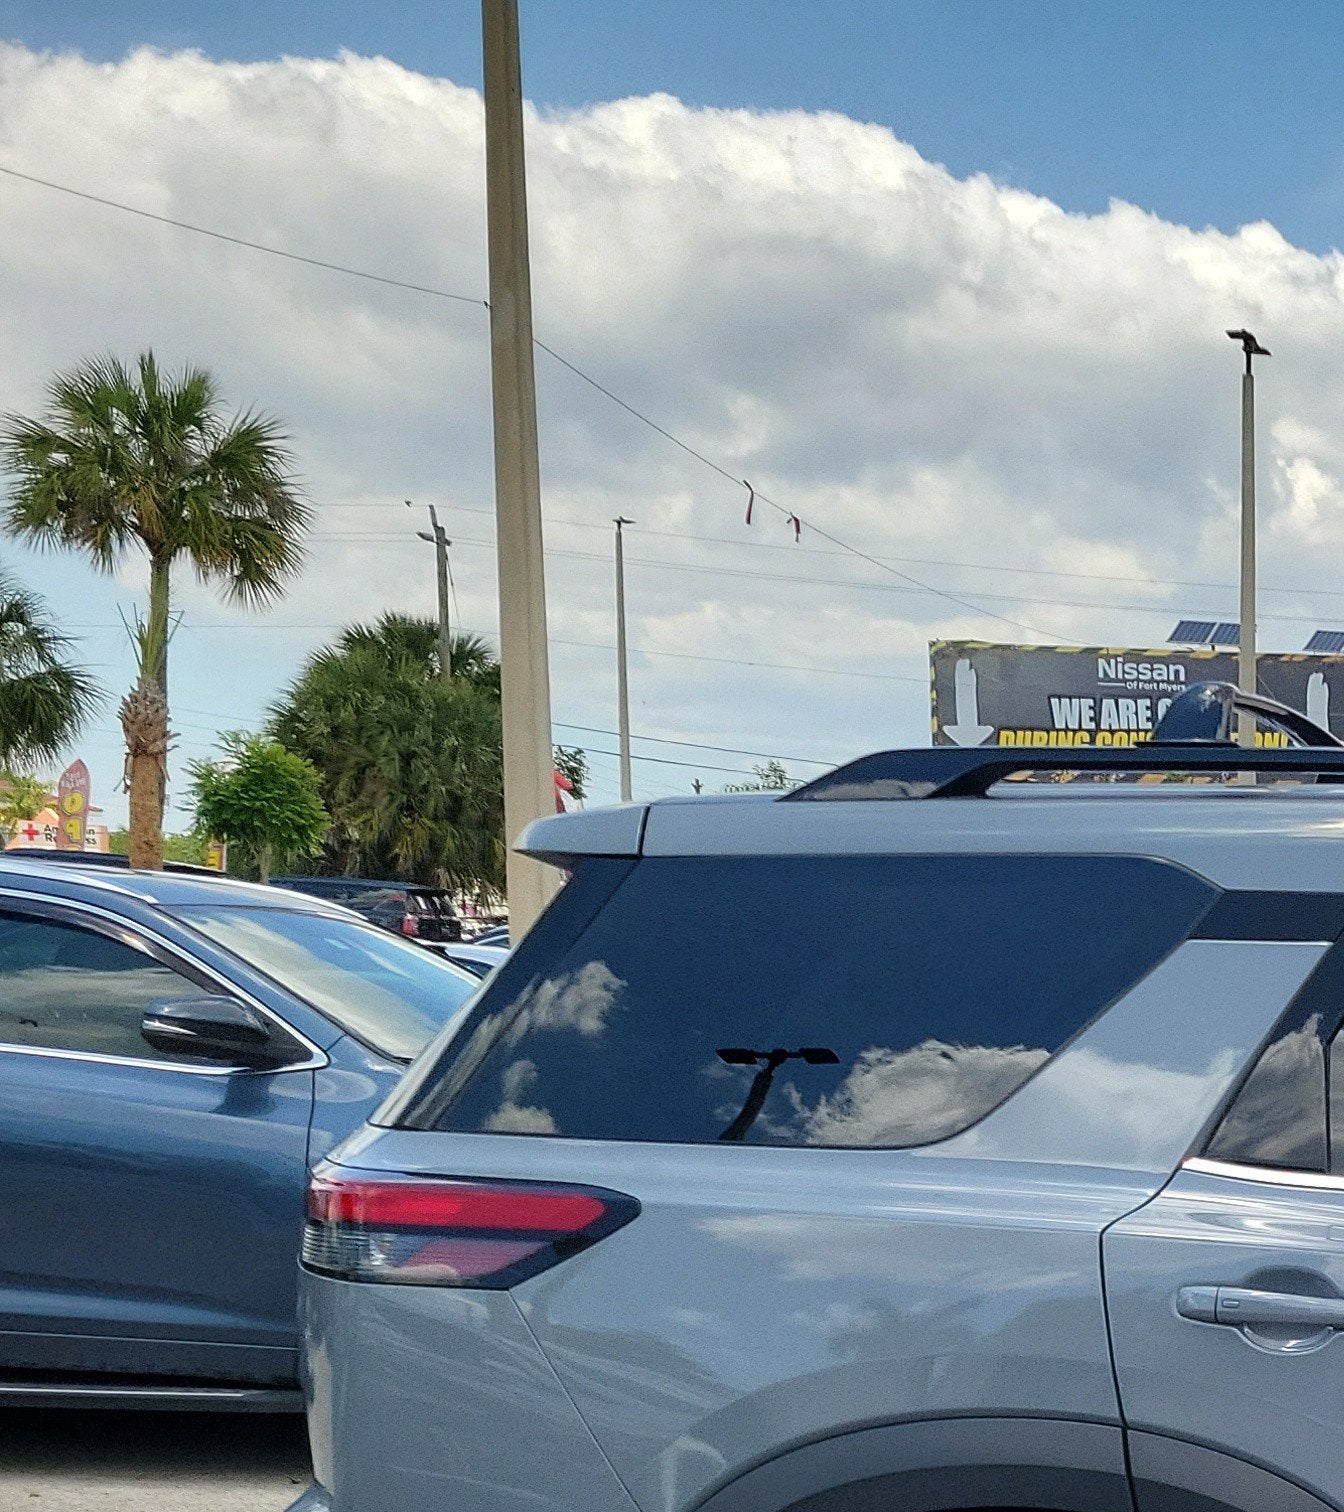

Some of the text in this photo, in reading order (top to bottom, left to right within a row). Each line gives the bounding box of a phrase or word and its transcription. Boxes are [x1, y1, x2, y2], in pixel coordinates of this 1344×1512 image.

[1098, 657, 1186, 682] Nissan
[1138, 681, 1158, 691] Fort
[1050, 697, 1096, 730] WE
[1100, 698, 1153, 730] ARE
